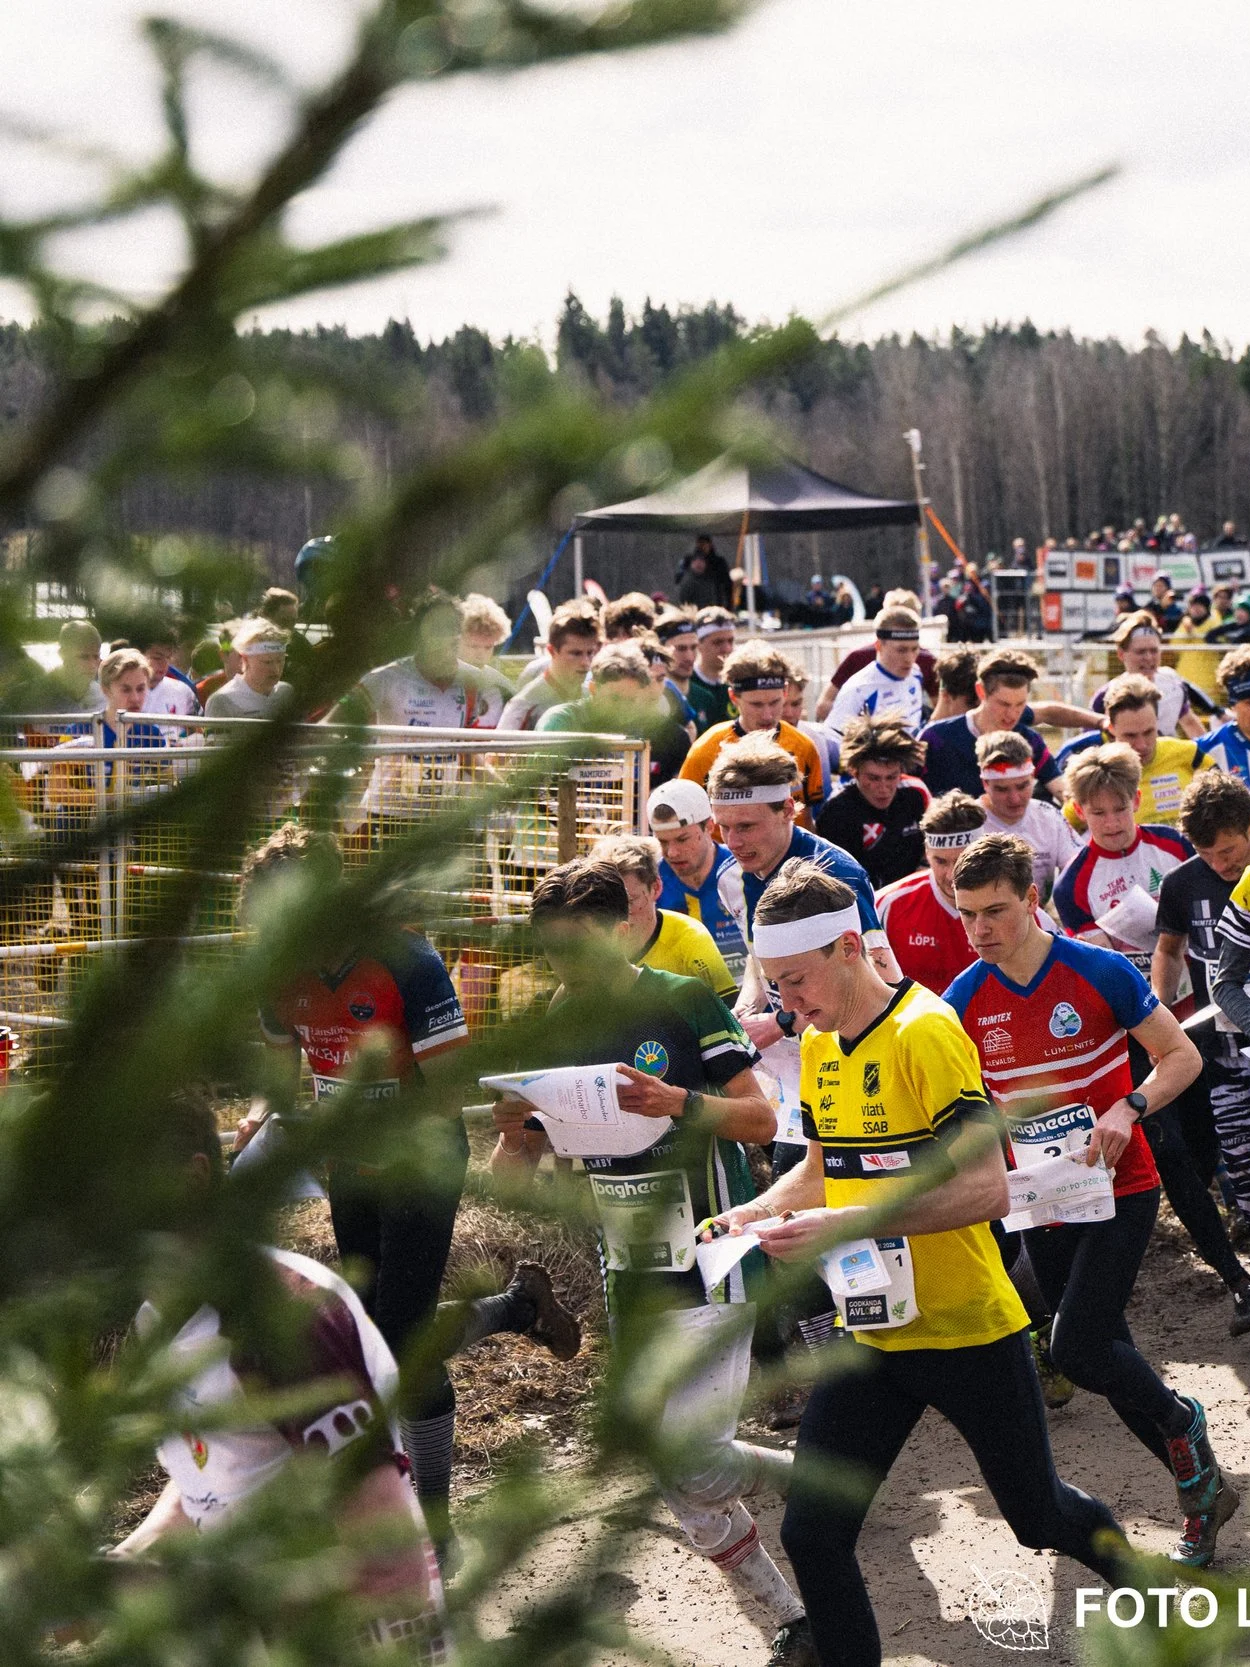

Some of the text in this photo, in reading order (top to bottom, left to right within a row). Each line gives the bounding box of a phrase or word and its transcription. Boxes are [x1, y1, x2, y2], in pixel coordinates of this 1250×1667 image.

[580, 769, 612, 778] RAMIRENT
[1107, 876, 1125, 890] TEAM
[1099, 885, 1128, 902] SPORTIA
[908, 932, 936, 946] LÖP1
[429, 1011, 453, 1028] Fresh
[977, 1011, 1012, 1027] TRIMTEX
[1044, 1038, 1096, 1057] LUMONITE
[985, 1056, 1016, 1067] ALEWALDS
[861, 1103, 887, 1117] viati
[862, 1121, 889, 1134] SSAB
[882, 1241, 896, 1249] 2026
[895, 1253, 903, 1267] 1
[848, 1298, 882, 1307] GODKÄNDA
